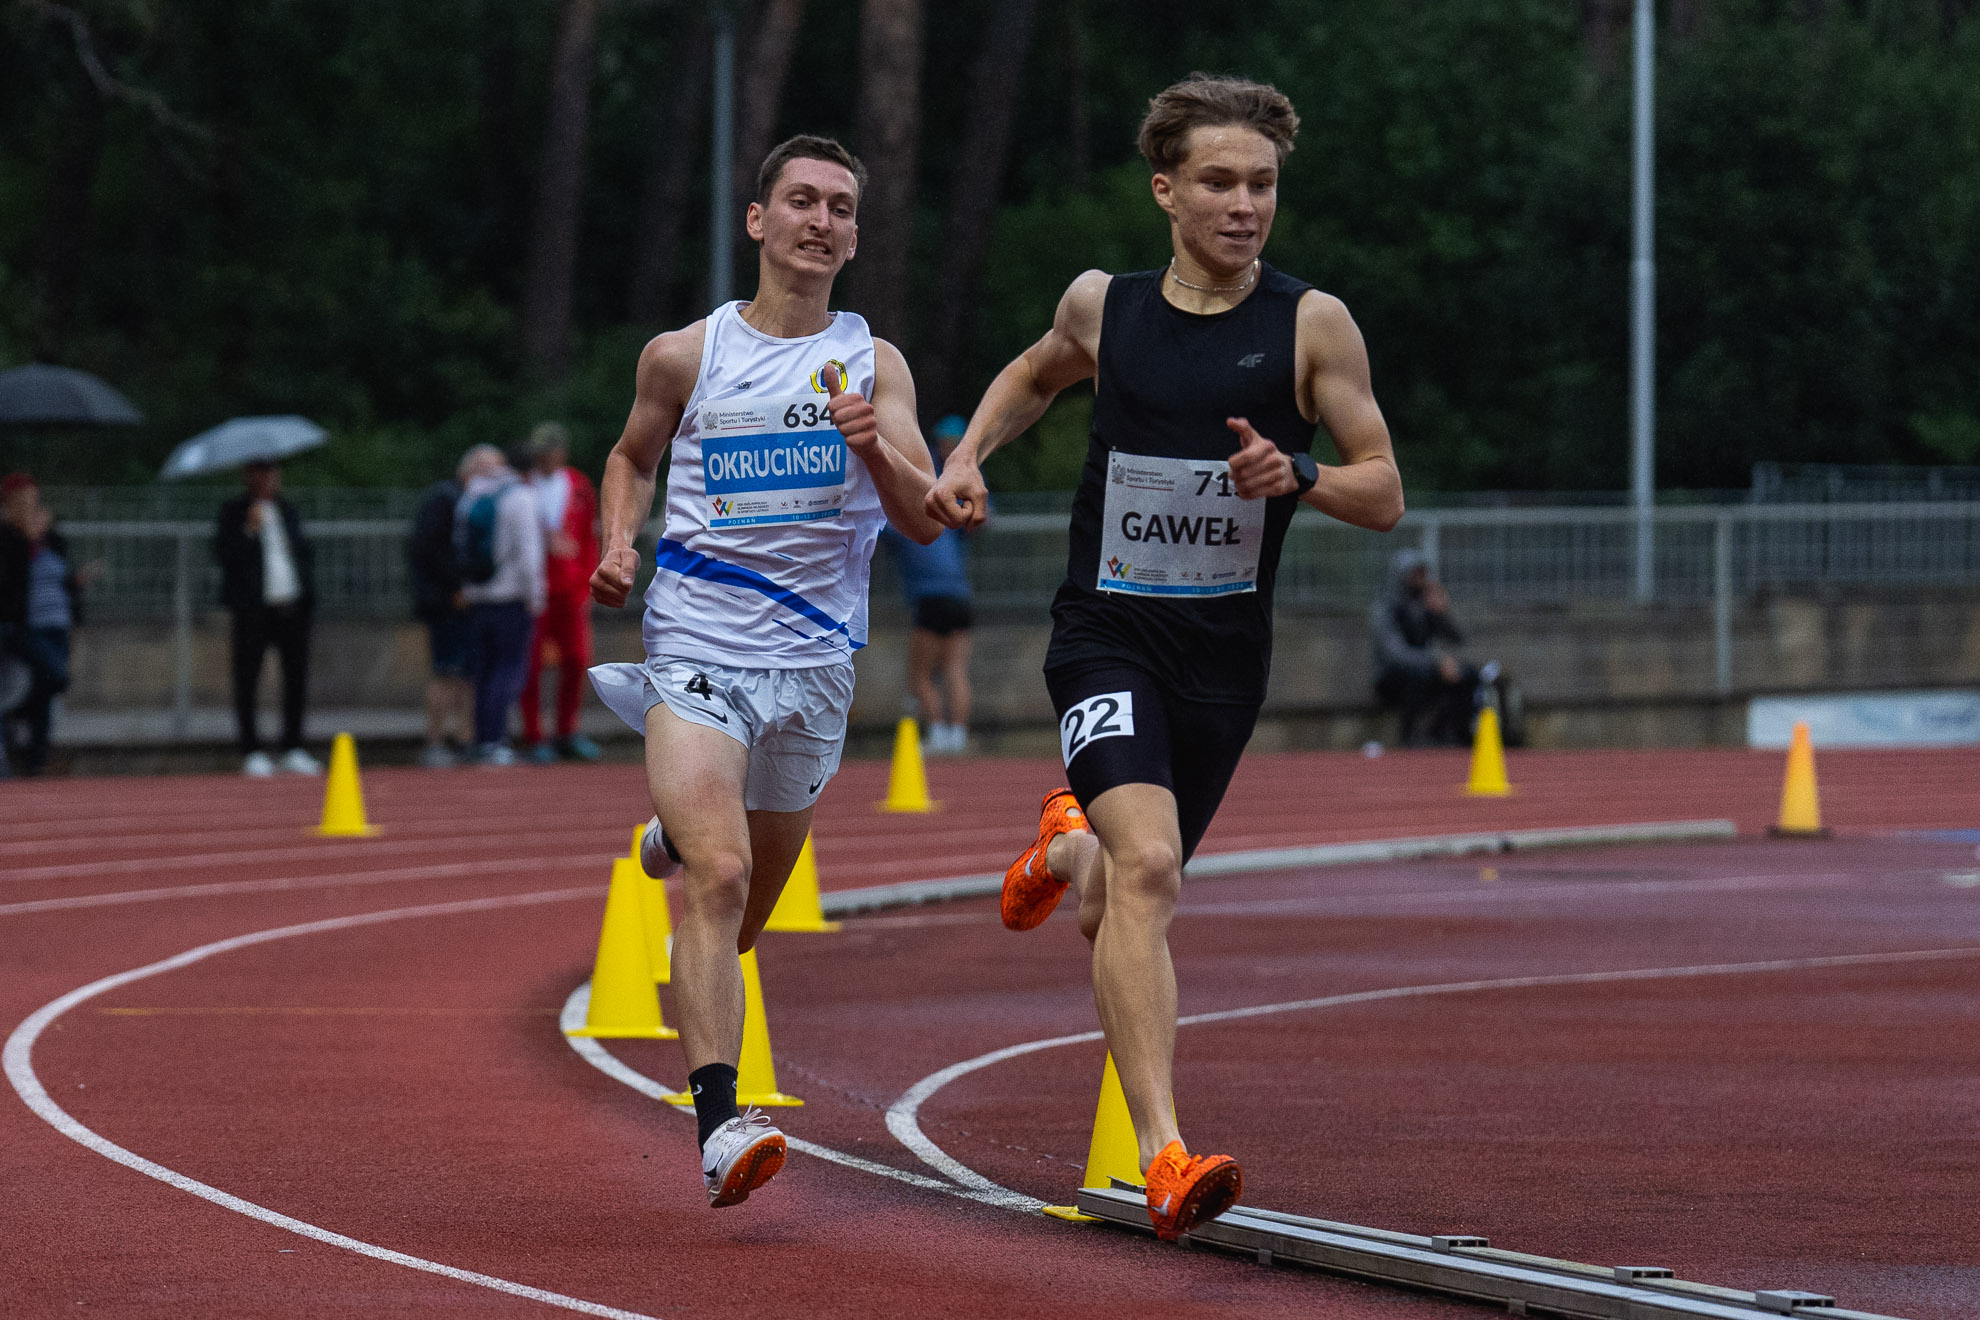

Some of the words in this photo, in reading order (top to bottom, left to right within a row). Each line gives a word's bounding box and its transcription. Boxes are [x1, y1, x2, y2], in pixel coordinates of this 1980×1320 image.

[708, 441, 841, 481] OKRUCIŃSKI
[1194, 470, 1241, 497] 71
[1121, 511, 1240, 546] GAWEŁ
[684, 673, 713, 701] 4
[1065, 698, 1120, 759] 22
